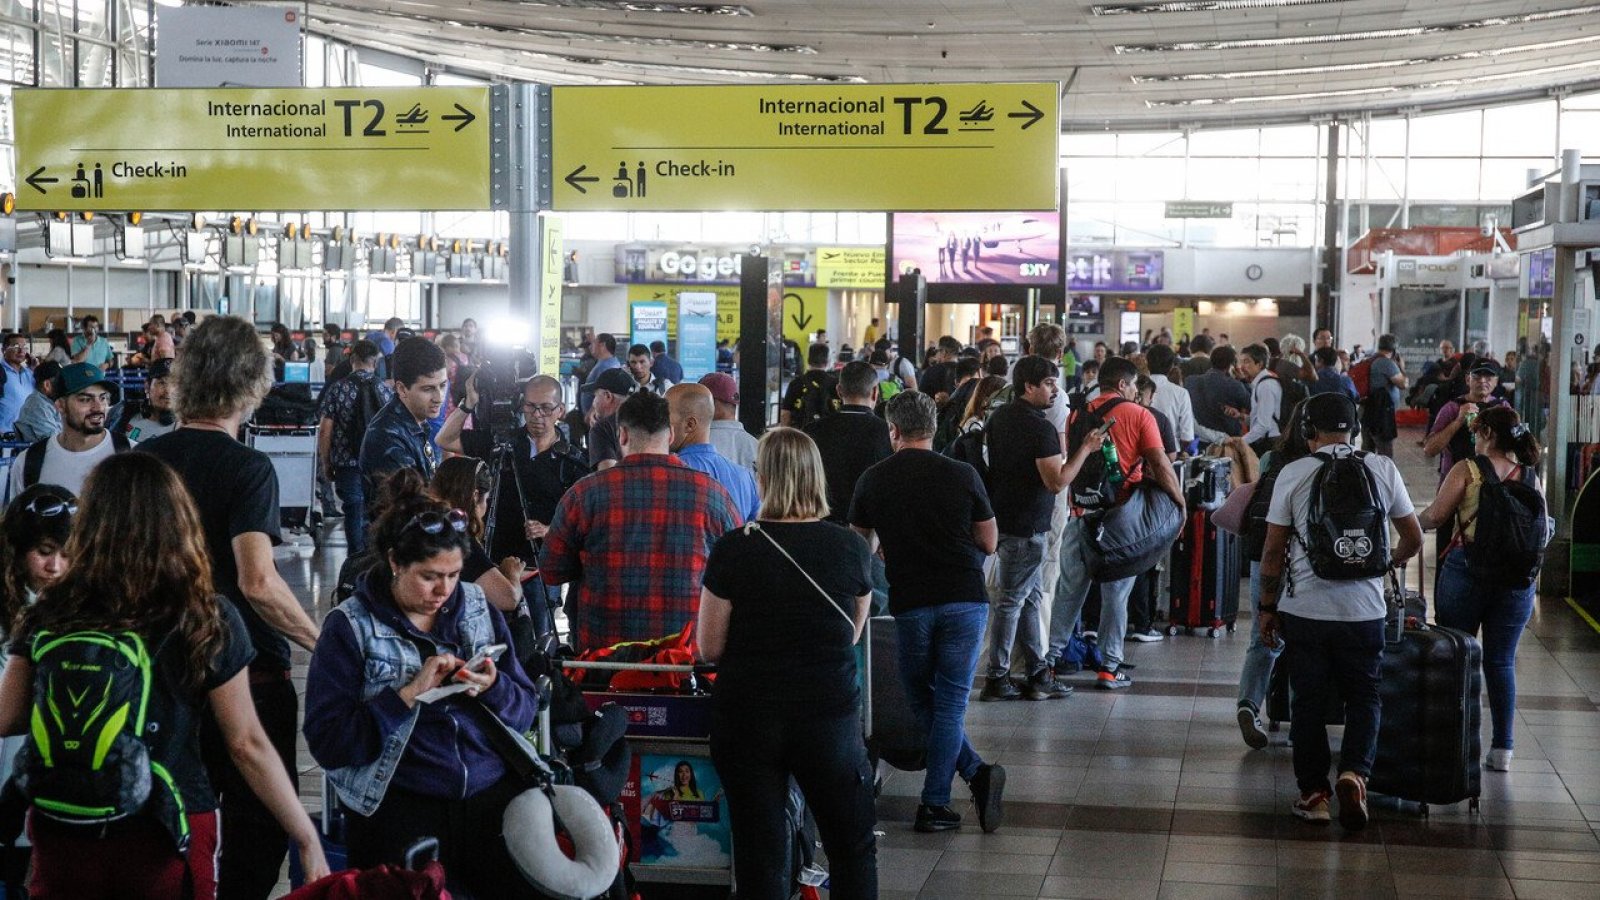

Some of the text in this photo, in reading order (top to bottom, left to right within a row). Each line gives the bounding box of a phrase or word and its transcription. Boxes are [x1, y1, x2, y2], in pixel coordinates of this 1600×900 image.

[178, 55, 203, 63] Domina
[224, 55, 250, 64] captura
[257, 55, 277, 63] noche
[208, 100, 326, 116] Internacional
[759, 97, 884, 114] Internacional
[334, 99, 387, 137] T2
[893, 96, 948, 135] T2
[226, 124, 326, 138] International
[778, 121, 884, 135] International
[112, 161, 187, 178] Check-in
[655, 160, 735, 176] Check-in
[660, 251, 697, 274] Go
[1019, 263, 1050, 276] SKY
[1093, 254, 1112, 280] it
[1418, 263, 1458, 272] POLO
[1343, 528, 1365, 537] PUMA
